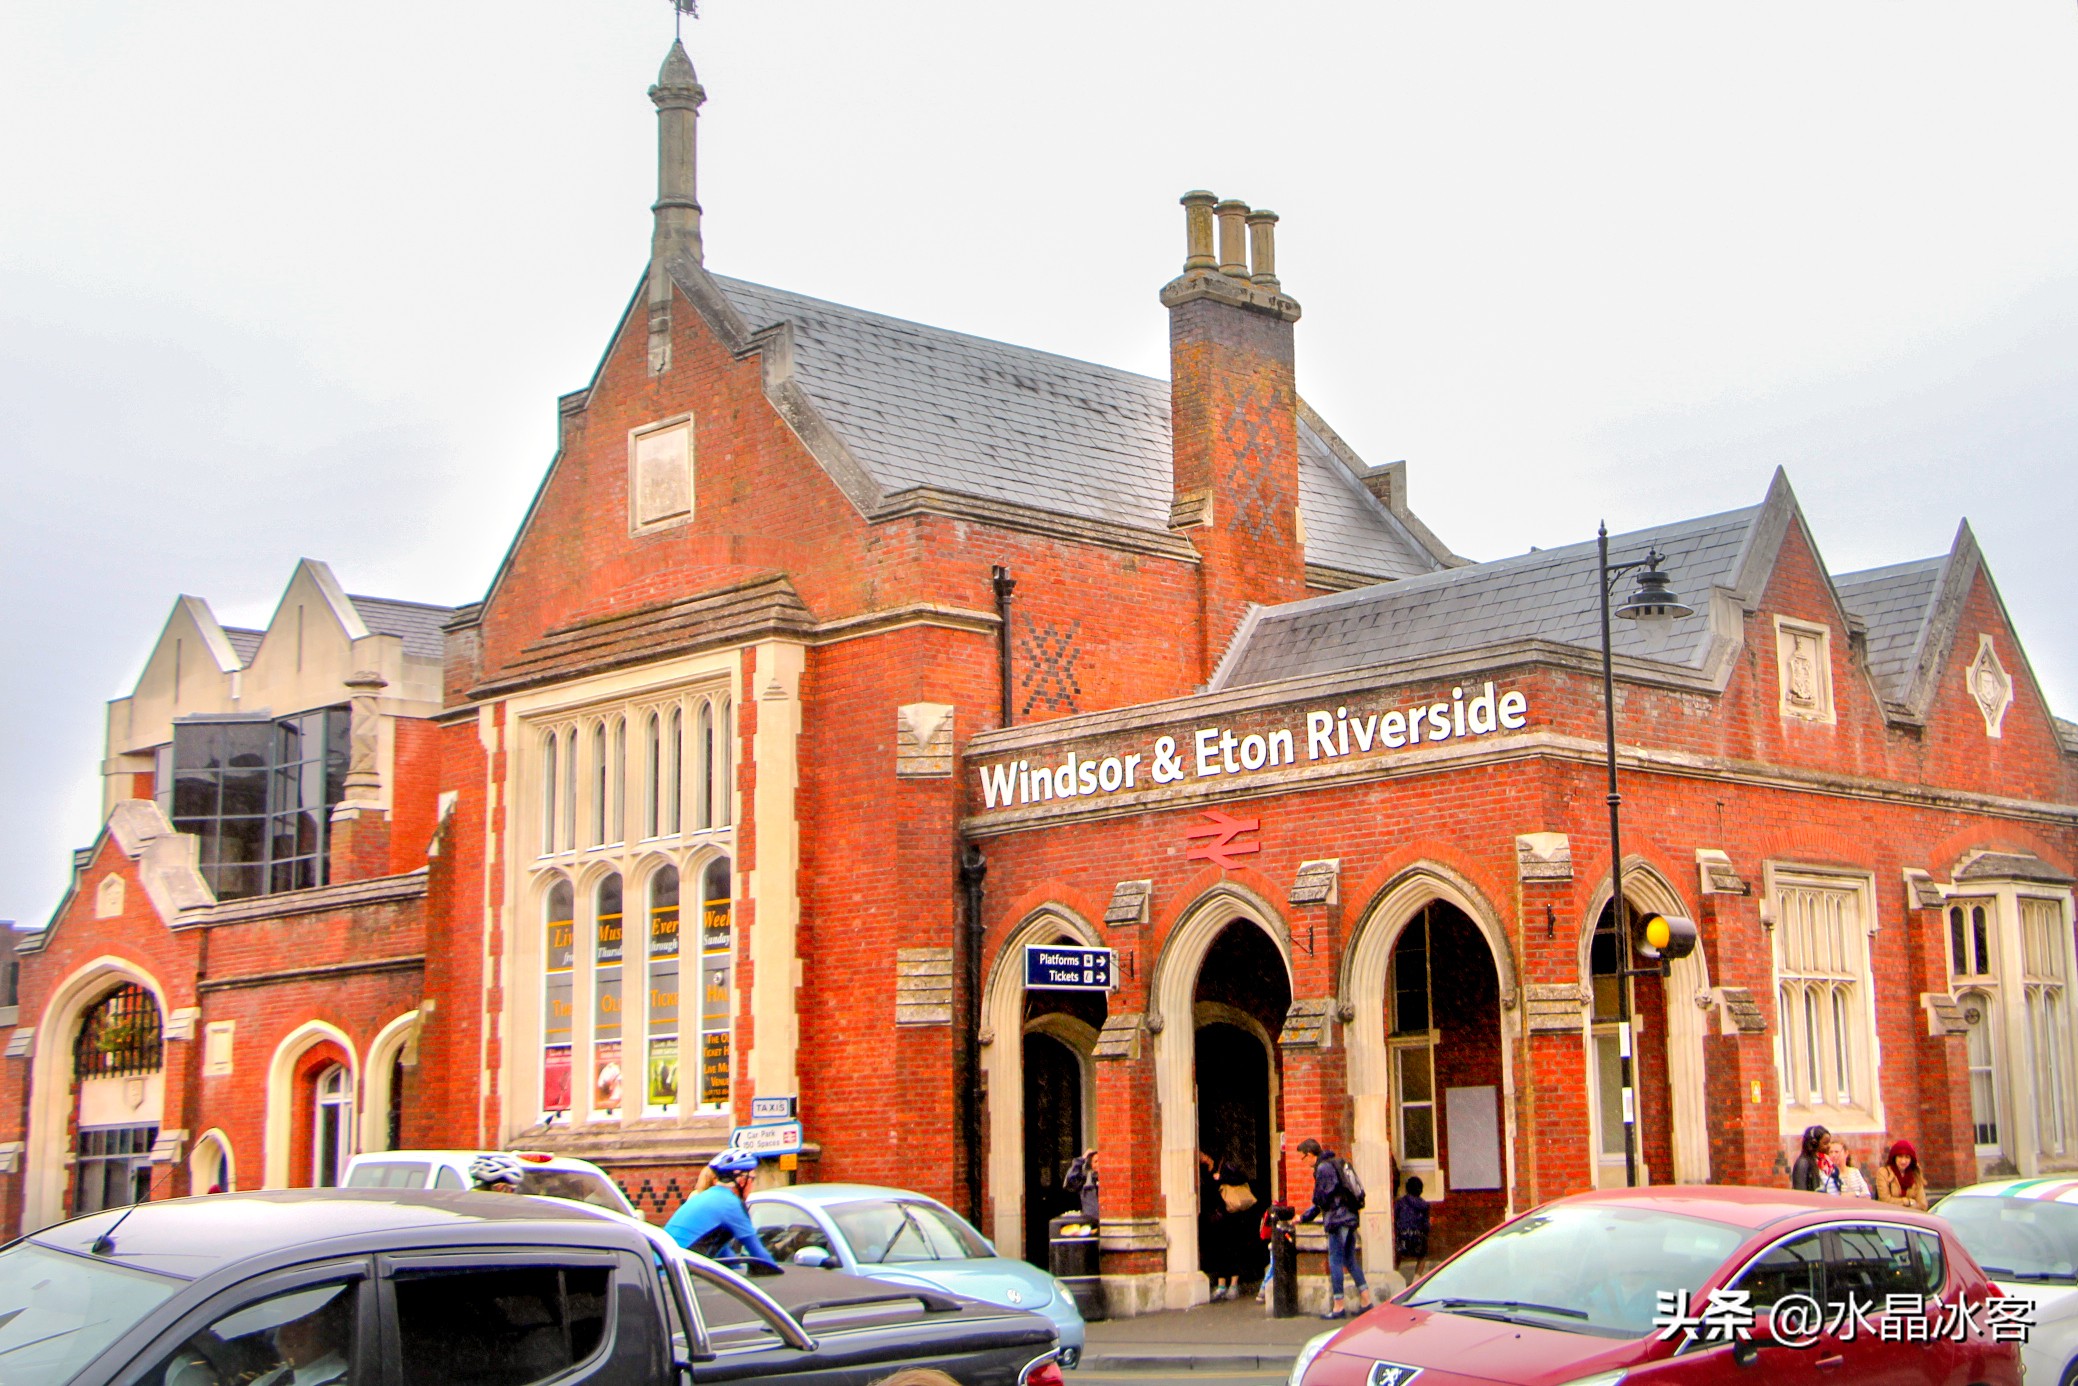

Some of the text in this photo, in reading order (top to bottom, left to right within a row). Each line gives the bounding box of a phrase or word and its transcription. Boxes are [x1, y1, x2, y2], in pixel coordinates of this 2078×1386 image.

[979, 681, 1528, 809] Windsor & Eton Riverside
[652, 917, 679, 938] Ever
[1039, 953, 1080, 966] Platforms
[1049, 970, 1079, 982] Tickets
[756, 1103, 785, 1112] TAXIS
[747, 1130, 776, 1139] Car Park
[757, 1140, 780, 1148] Spaces
